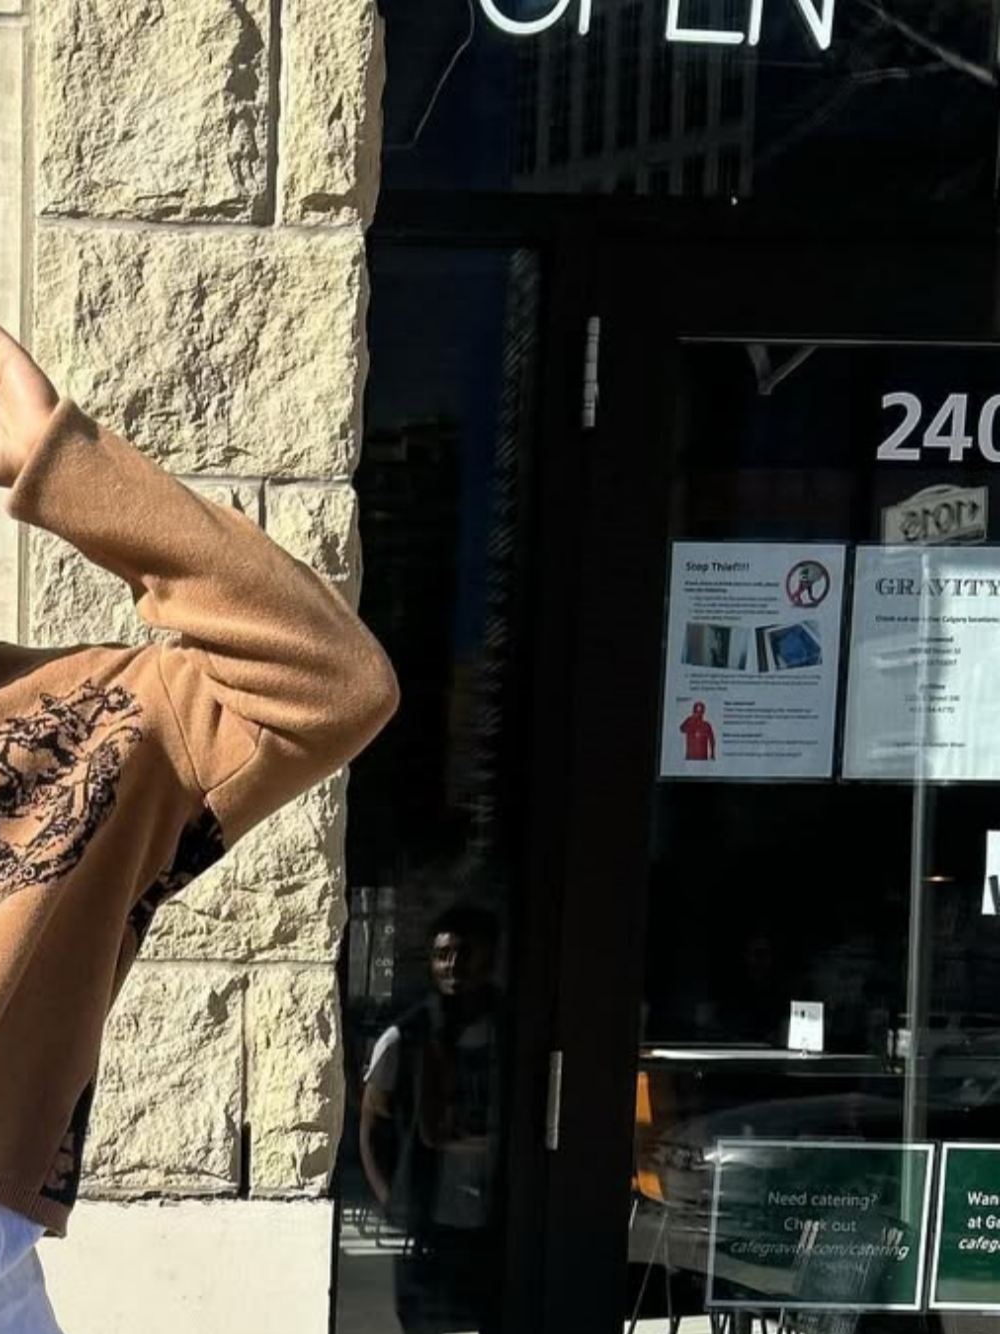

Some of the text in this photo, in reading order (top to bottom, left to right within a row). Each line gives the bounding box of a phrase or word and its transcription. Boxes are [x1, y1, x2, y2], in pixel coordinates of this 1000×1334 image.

[685, 562, 709, 574] Stop
[768, 1191, 879, 1211] Need catering?
[832, 1220, 857, 1232] out
[967, 1216, 982, 1229] at
[958, 1236, 1000, 1253] cafeg
